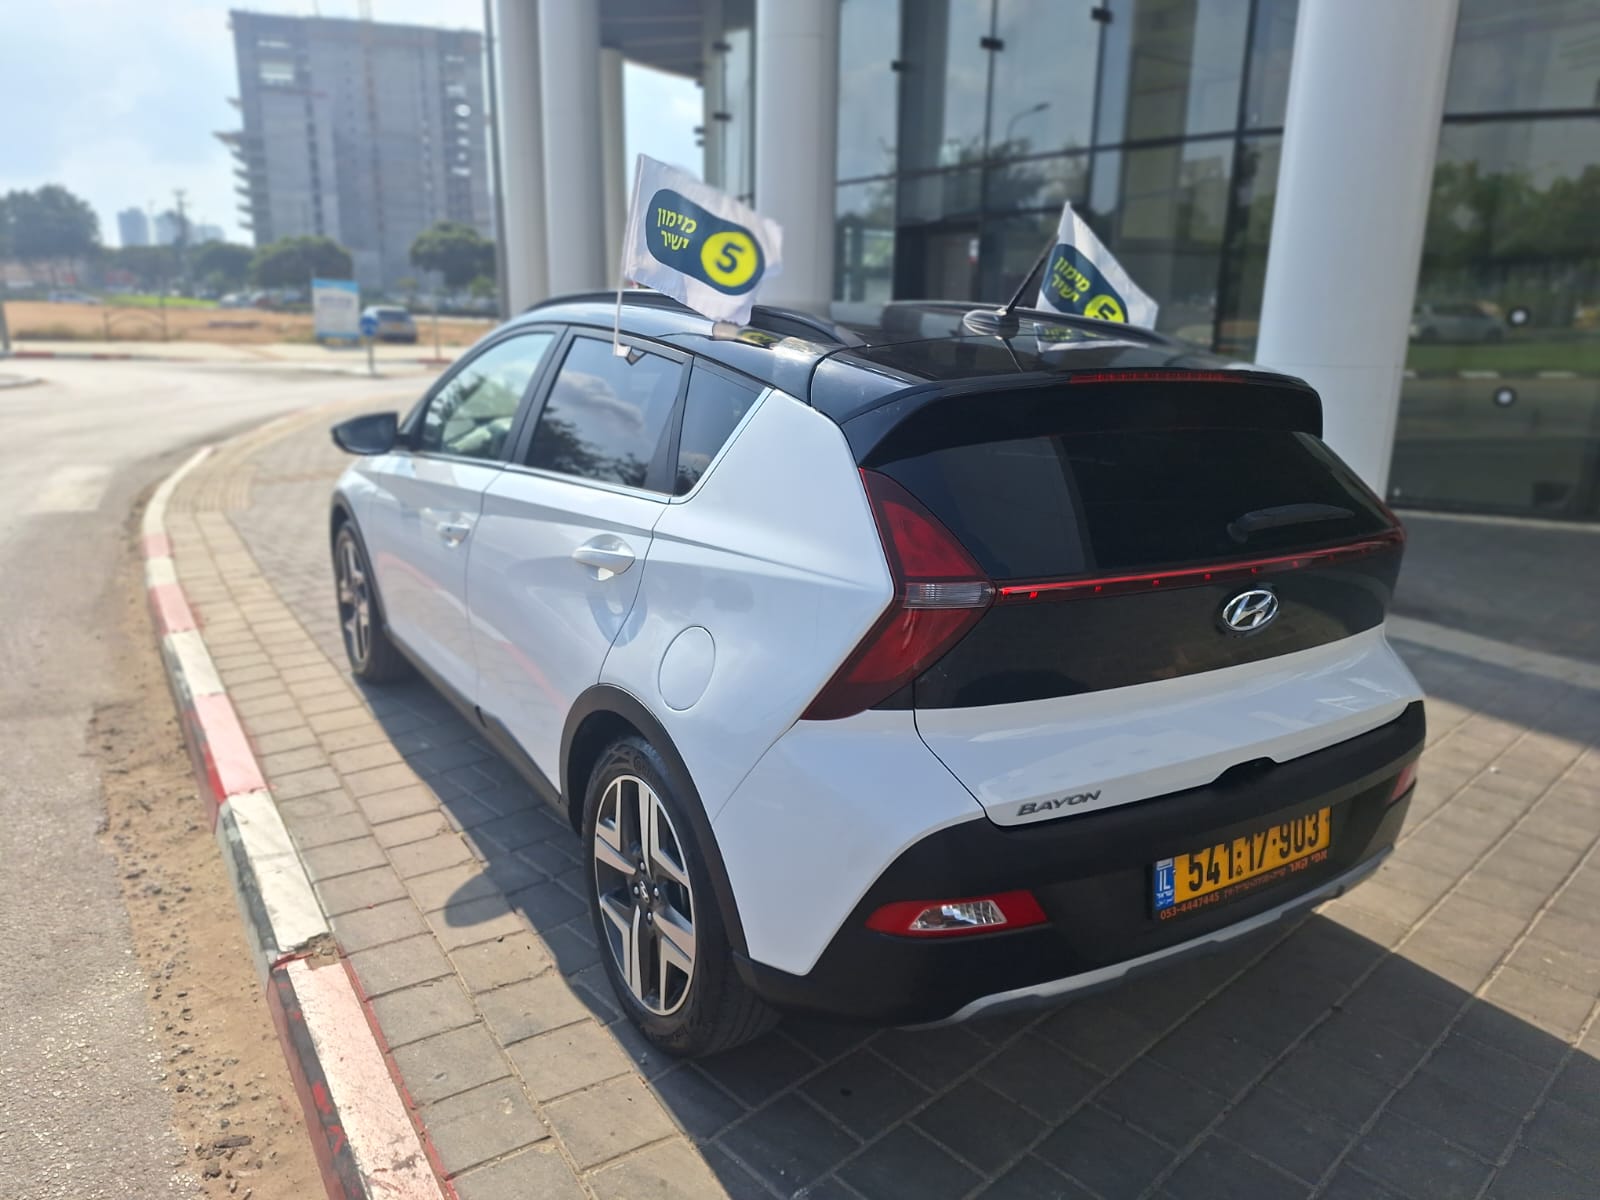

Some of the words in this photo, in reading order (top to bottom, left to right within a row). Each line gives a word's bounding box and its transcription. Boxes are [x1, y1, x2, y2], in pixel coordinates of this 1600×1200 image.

[657, 207, 697, 234] מימון
[661, 230, 690, 251] ישיר
[715, 241, 744, 274] 5
[1053, 256, 1091, 292] מימון
[1016, 789, 1102, 816] BAYON
[1159, 869, 1171, 891] IL
